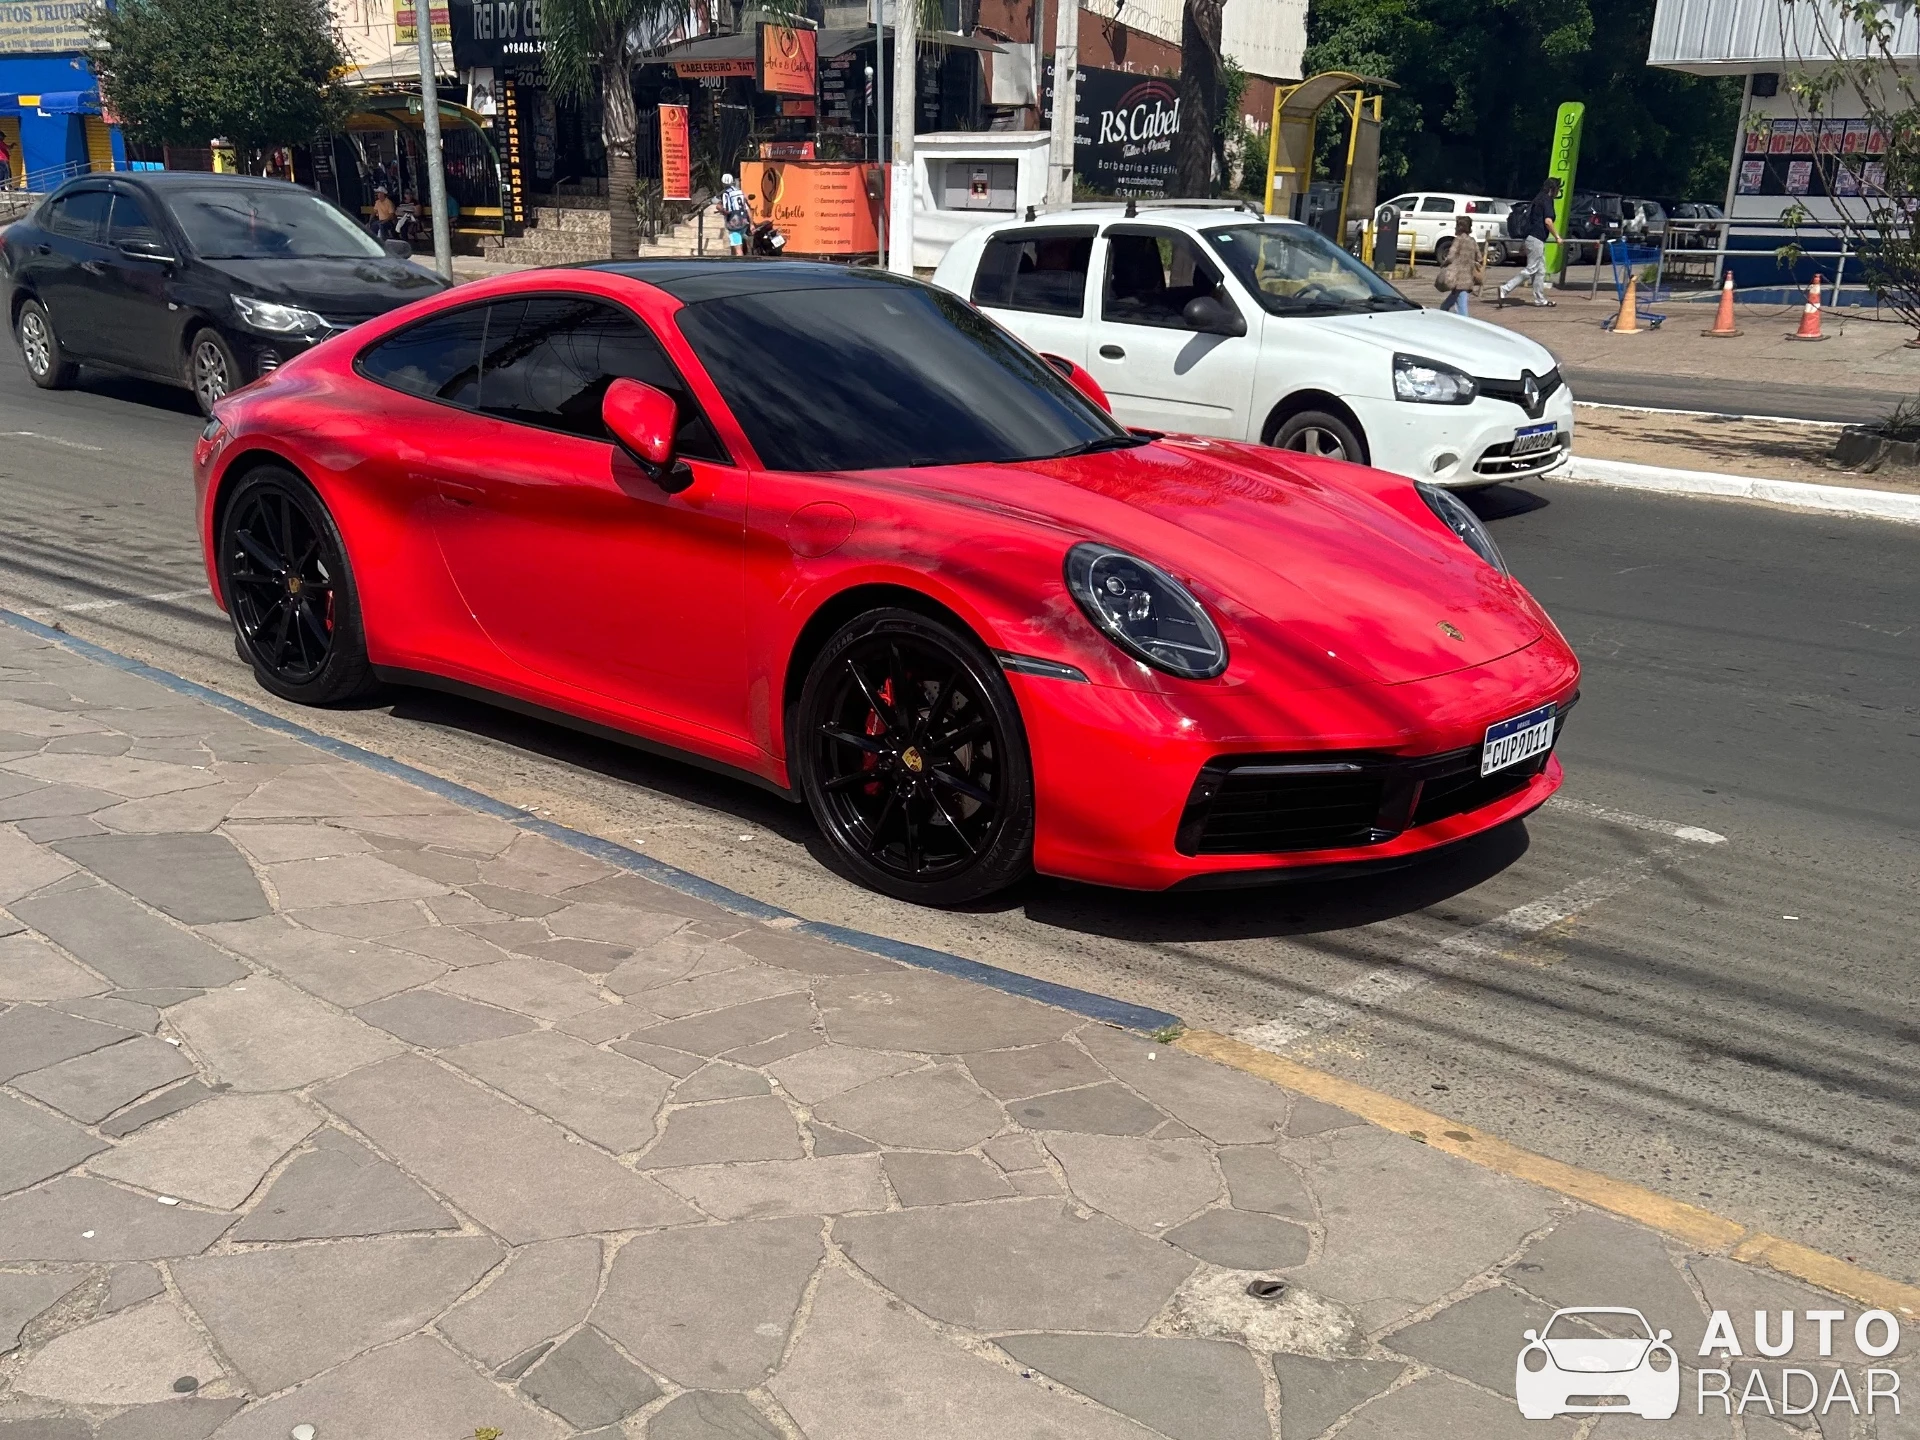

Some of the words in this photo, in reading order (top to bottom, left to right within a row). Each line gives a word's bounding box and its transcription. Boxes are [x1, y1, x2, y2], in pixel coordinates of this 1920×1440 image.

[473, 3, 494, 40] REI
[498, 2, 518, 38] DO
[1557, 113, 1575, 172] pague
[1098, 159, 1142, 173] Barbearia
[774, 203, 805, 220] Cabello
[1491, 722, 1549, 769] CUP9D11
